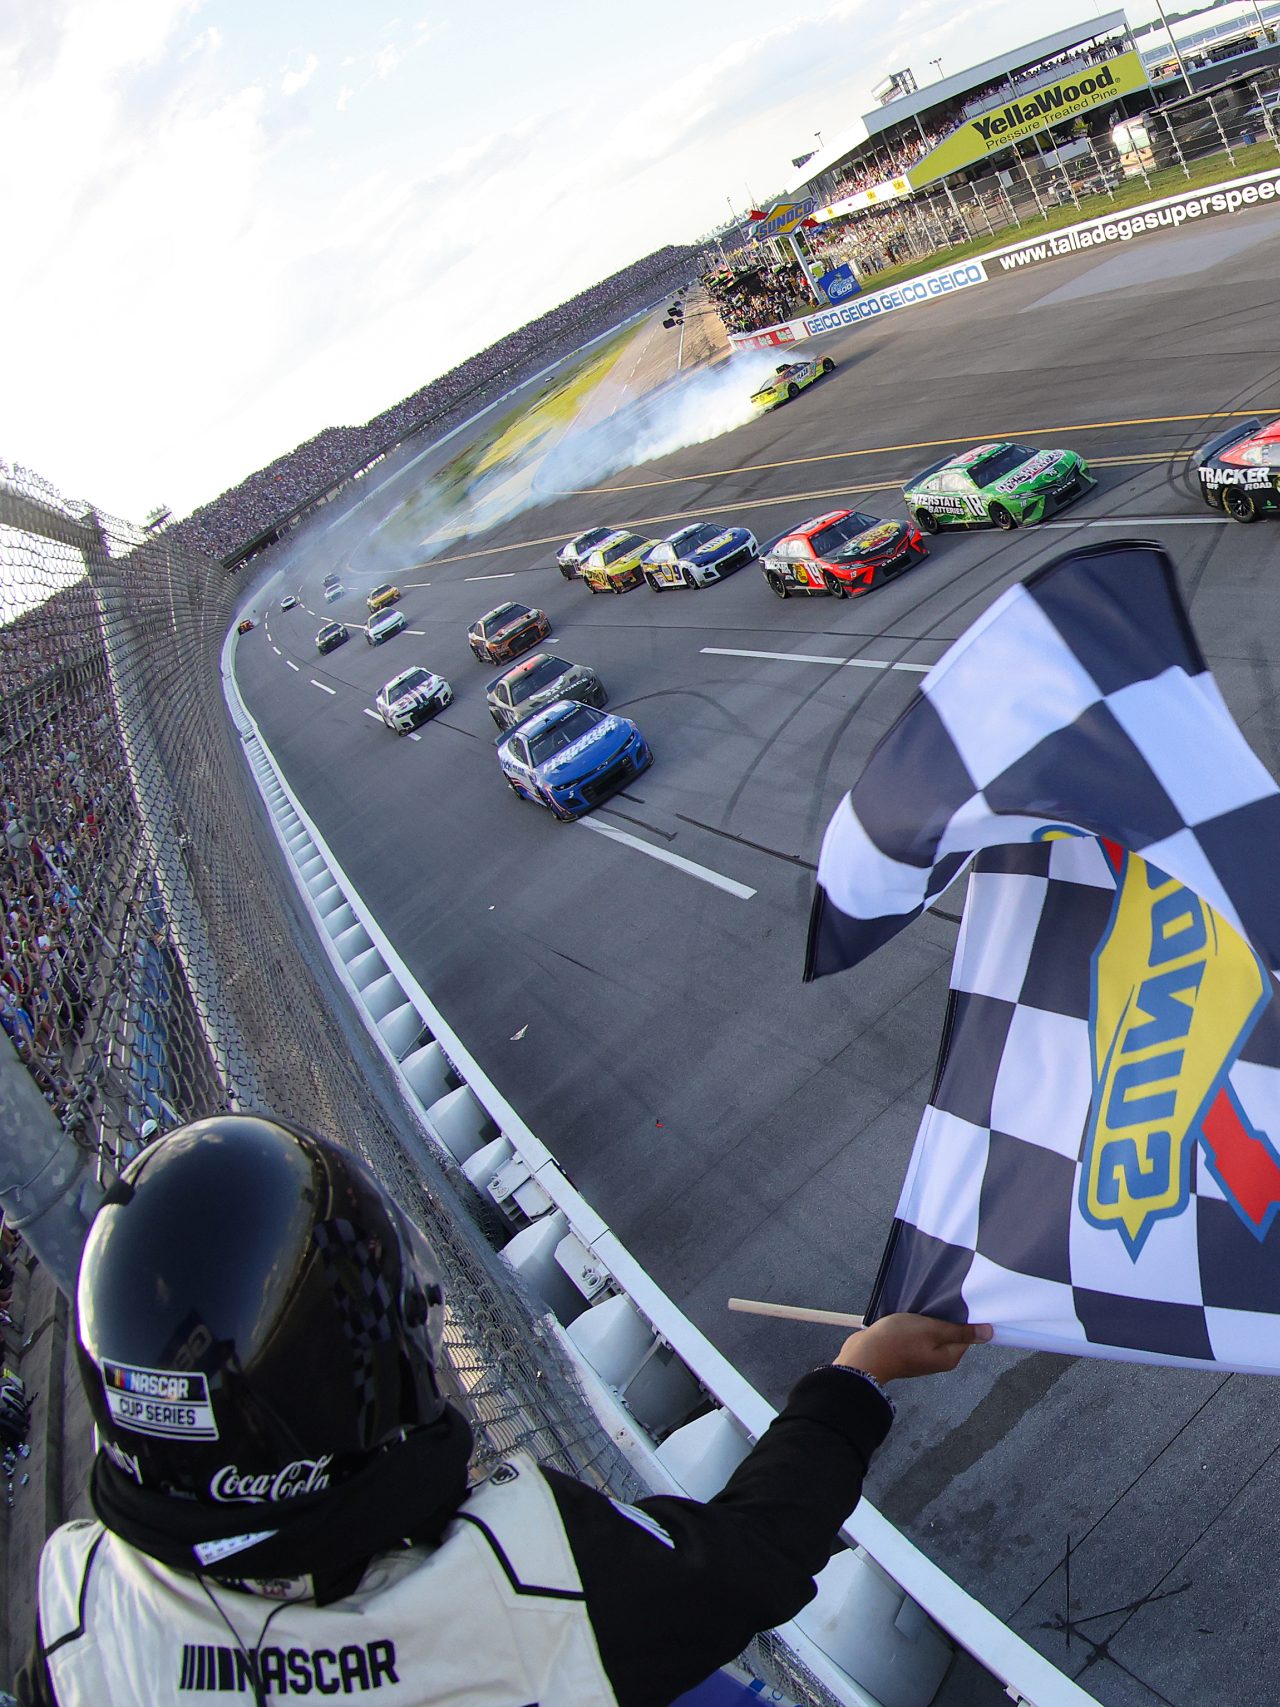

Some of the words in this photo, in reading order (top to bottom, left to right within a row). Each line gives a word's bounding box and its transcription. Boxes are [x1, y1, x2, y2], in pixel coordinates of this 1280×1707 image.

[971, 66, 1114, 140] YellaWood
[985, 119, 1040, 150] Pressure
[1041, 97, 1089, 123] Treated
[1091, 87, 1118, 104] Pine
[758, 199, 812, 237] SUNOCO
[808, 310, 842, 334] GEICO
[841, 297, 881, 324] GEICO
[880, 283, 928, 312] GEICO
[930, 265, 982, 295] GEICO
[1198, 467, 1270, 485] TRACKER
[1206, 482, 1219, 490] OFF
[1244, 482, 1273, 491] ROAD
[911, 495, 962, 508] INTERSTATE
[928, 505, 964, 515] BATTERIES
[964, 494, 987, 517] 18
[673, 564, 681, 581] 9
[805, 561, 825, 585] 19
[130, 1371, 190, 1399] NASCAR
[119, 1398, 143, 1417] CUP
[145, 1404, 196, 1426] SERIES
[209, 1453, 335, 1503] Coca-Cola
[233, 1638, 400, 1695] NASCAR
